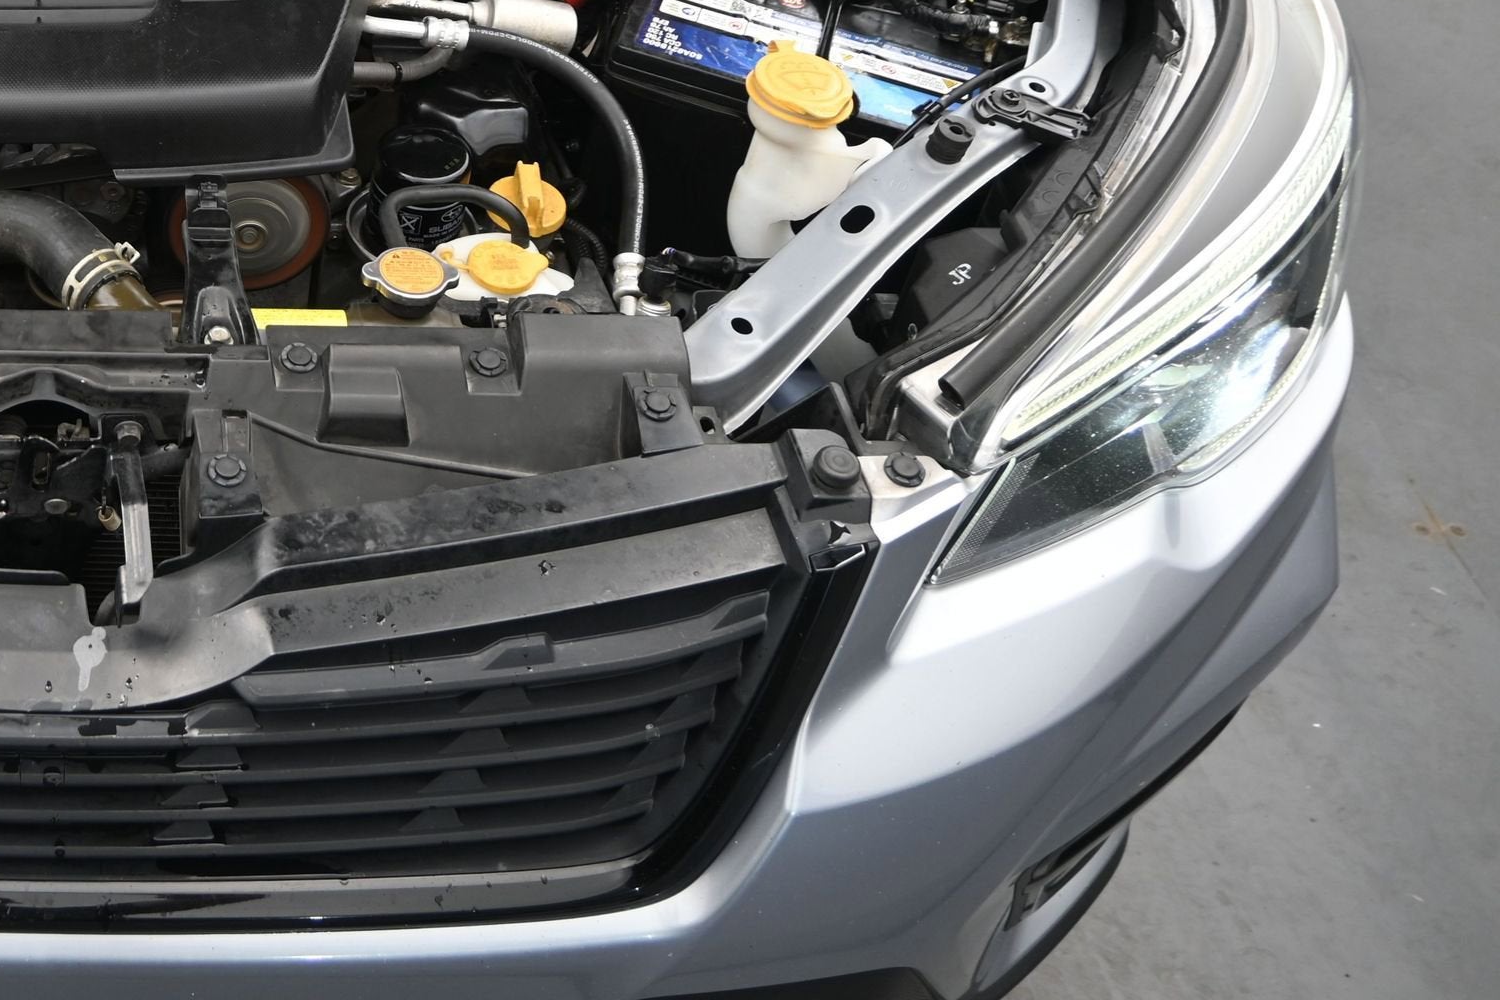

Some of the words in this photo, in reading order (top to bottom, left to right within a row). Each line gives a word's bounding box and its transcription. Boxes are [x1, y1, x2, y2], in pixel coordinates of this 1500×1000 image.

[663, 37, 682, 47] CCA
[665, 32, 679, 40] RC
[428, 218, 462, 234] SUBA
[947, 263, 972, 286] JP
